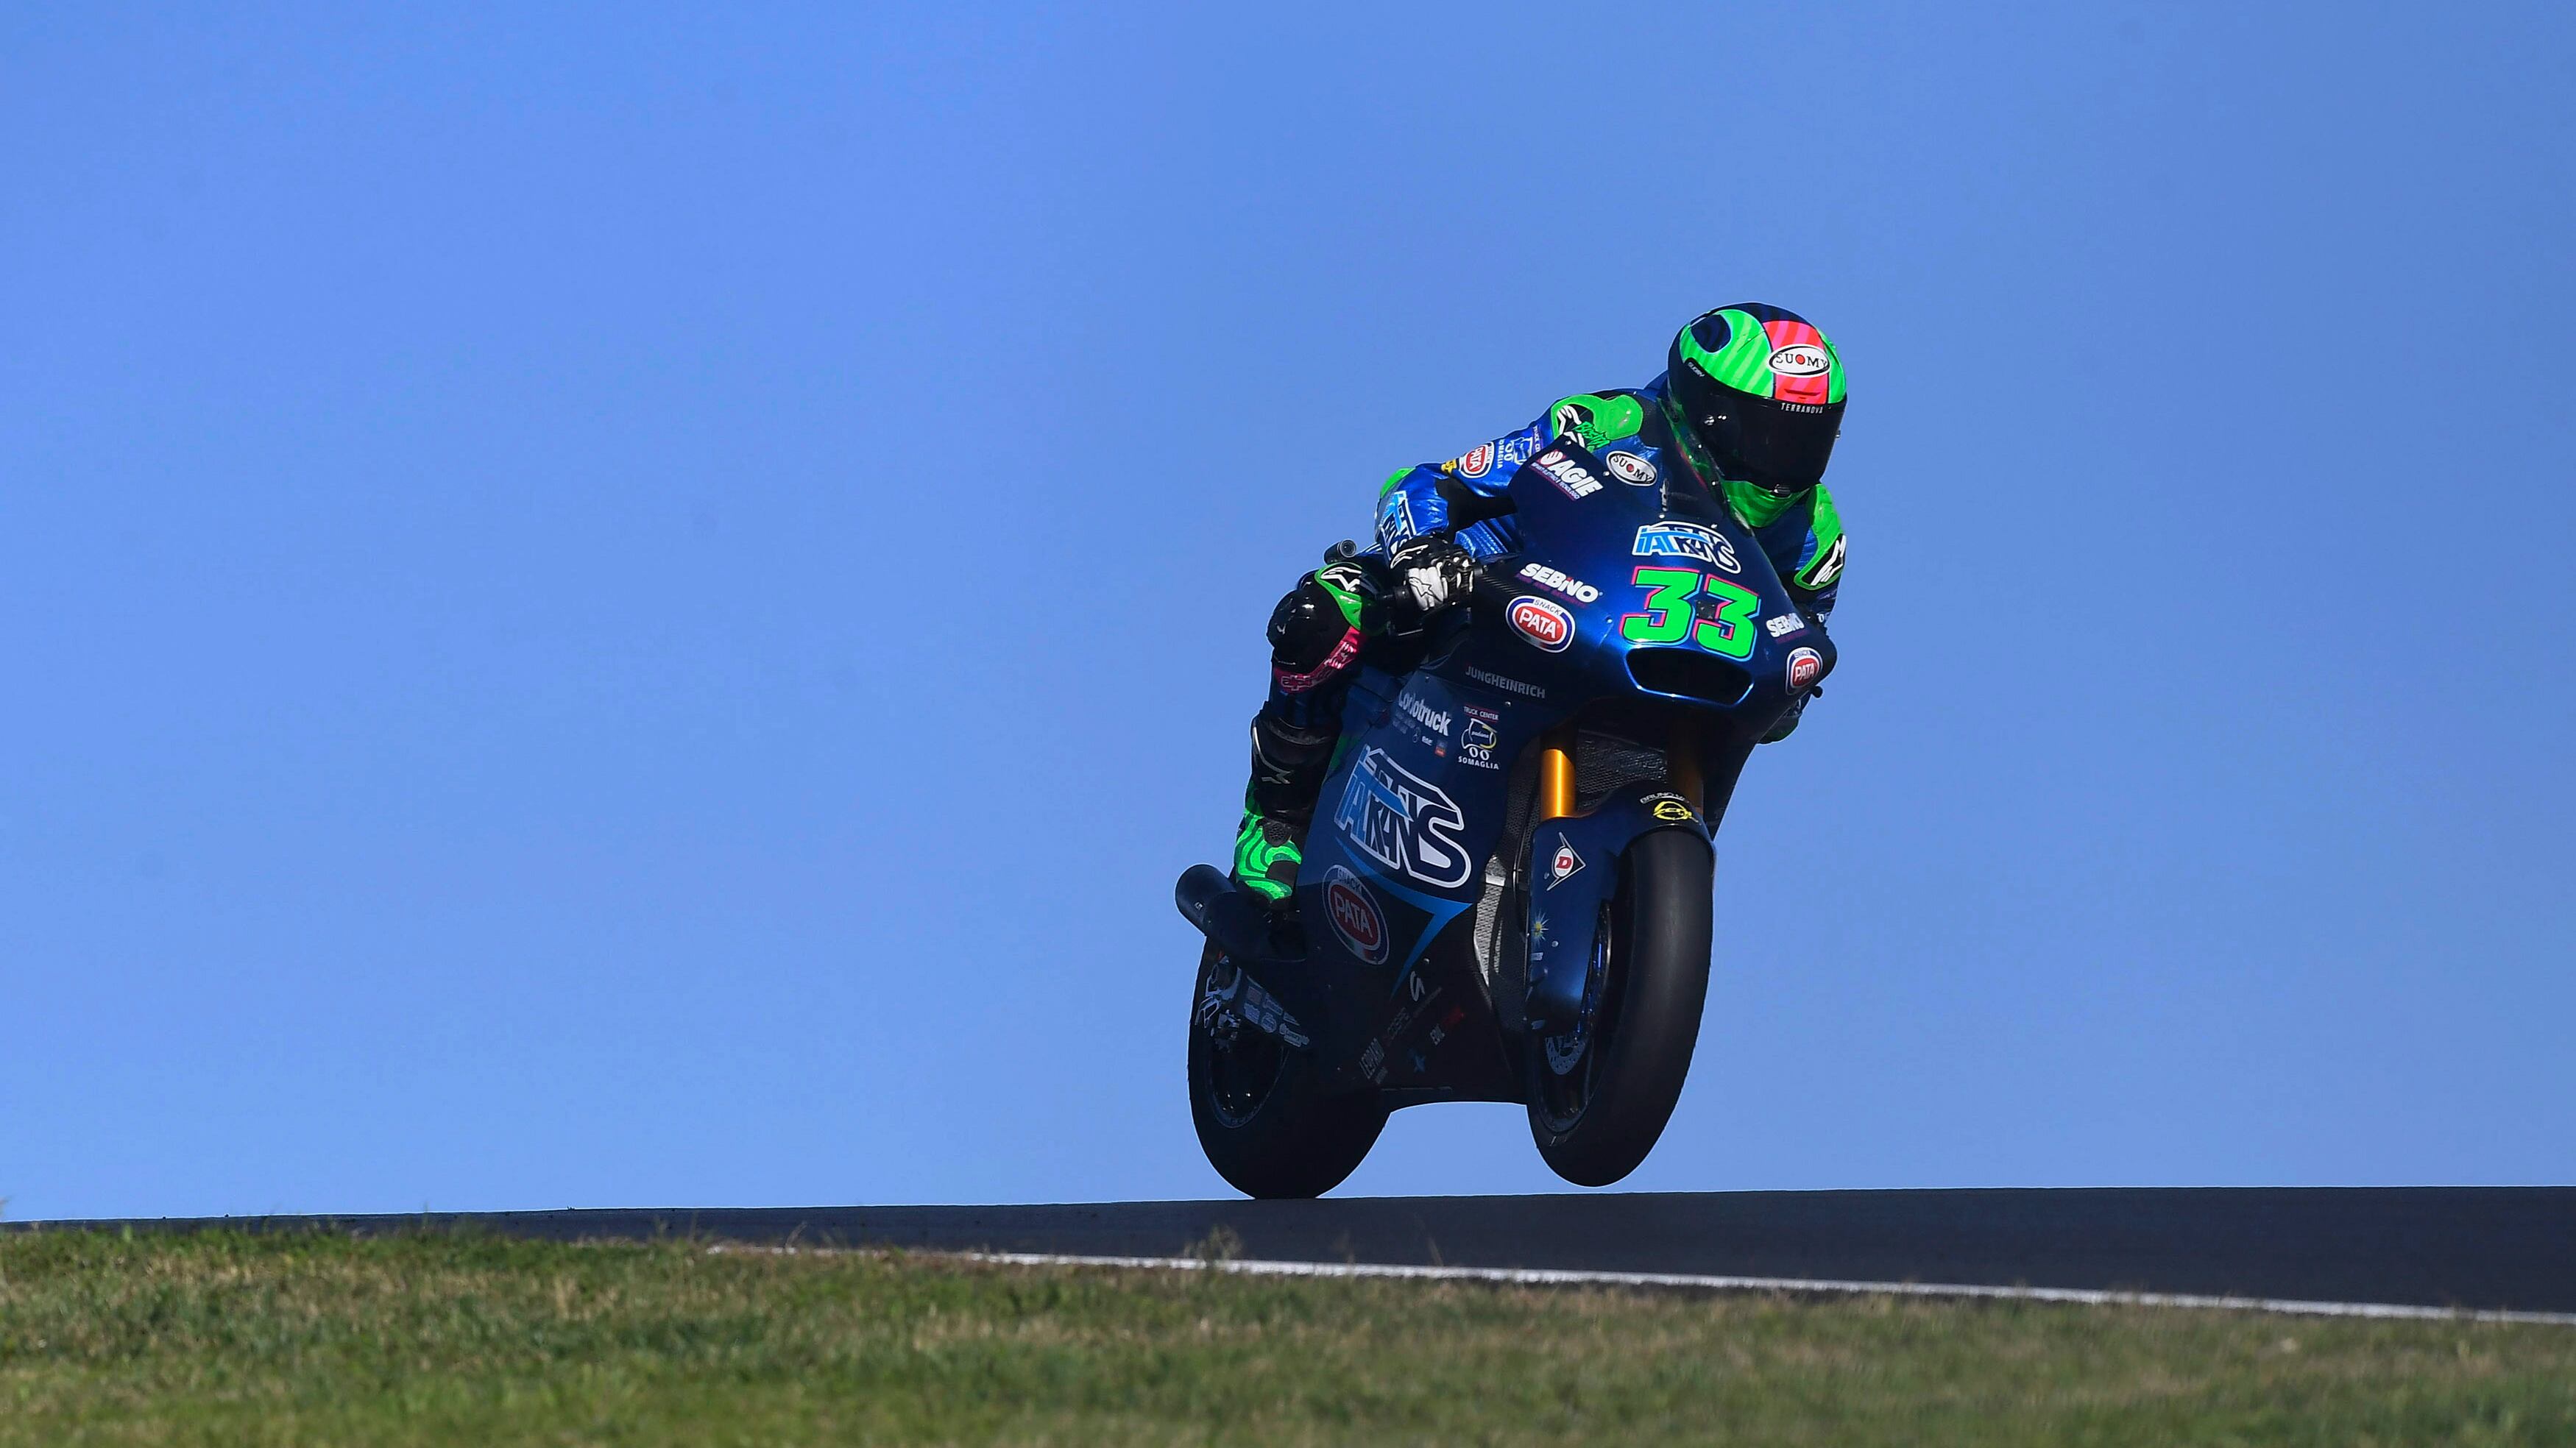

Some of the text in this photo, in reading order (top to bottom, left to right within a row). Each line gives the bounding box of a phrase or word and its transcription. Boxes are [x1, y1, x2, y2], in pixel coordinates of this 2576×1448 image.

[1775, 352, 1828, 369] SUOMY
[1780, 402, 1824, 414] TERRANOVA
[1547, 459, 1604, 497] AGIE
[1613, 455, 1652, 482] SUOMY
[1533, 599, 1562, 616] SNACK
[1619, 566, 1761, 661] 33
[1518, 609, 1558, 639] PATA
[1465, 666, 1546, 698] JUNGHEINRICH
[1794, 662, 1815, 683] PATA
[1463, 706, 1499, 721] TRUCK CENTER
[1458, 756, 1499, 770] SOMAGLIA
[1555, 856, 1572, 870] D
[1334, 891, 1373, 939] PATA
